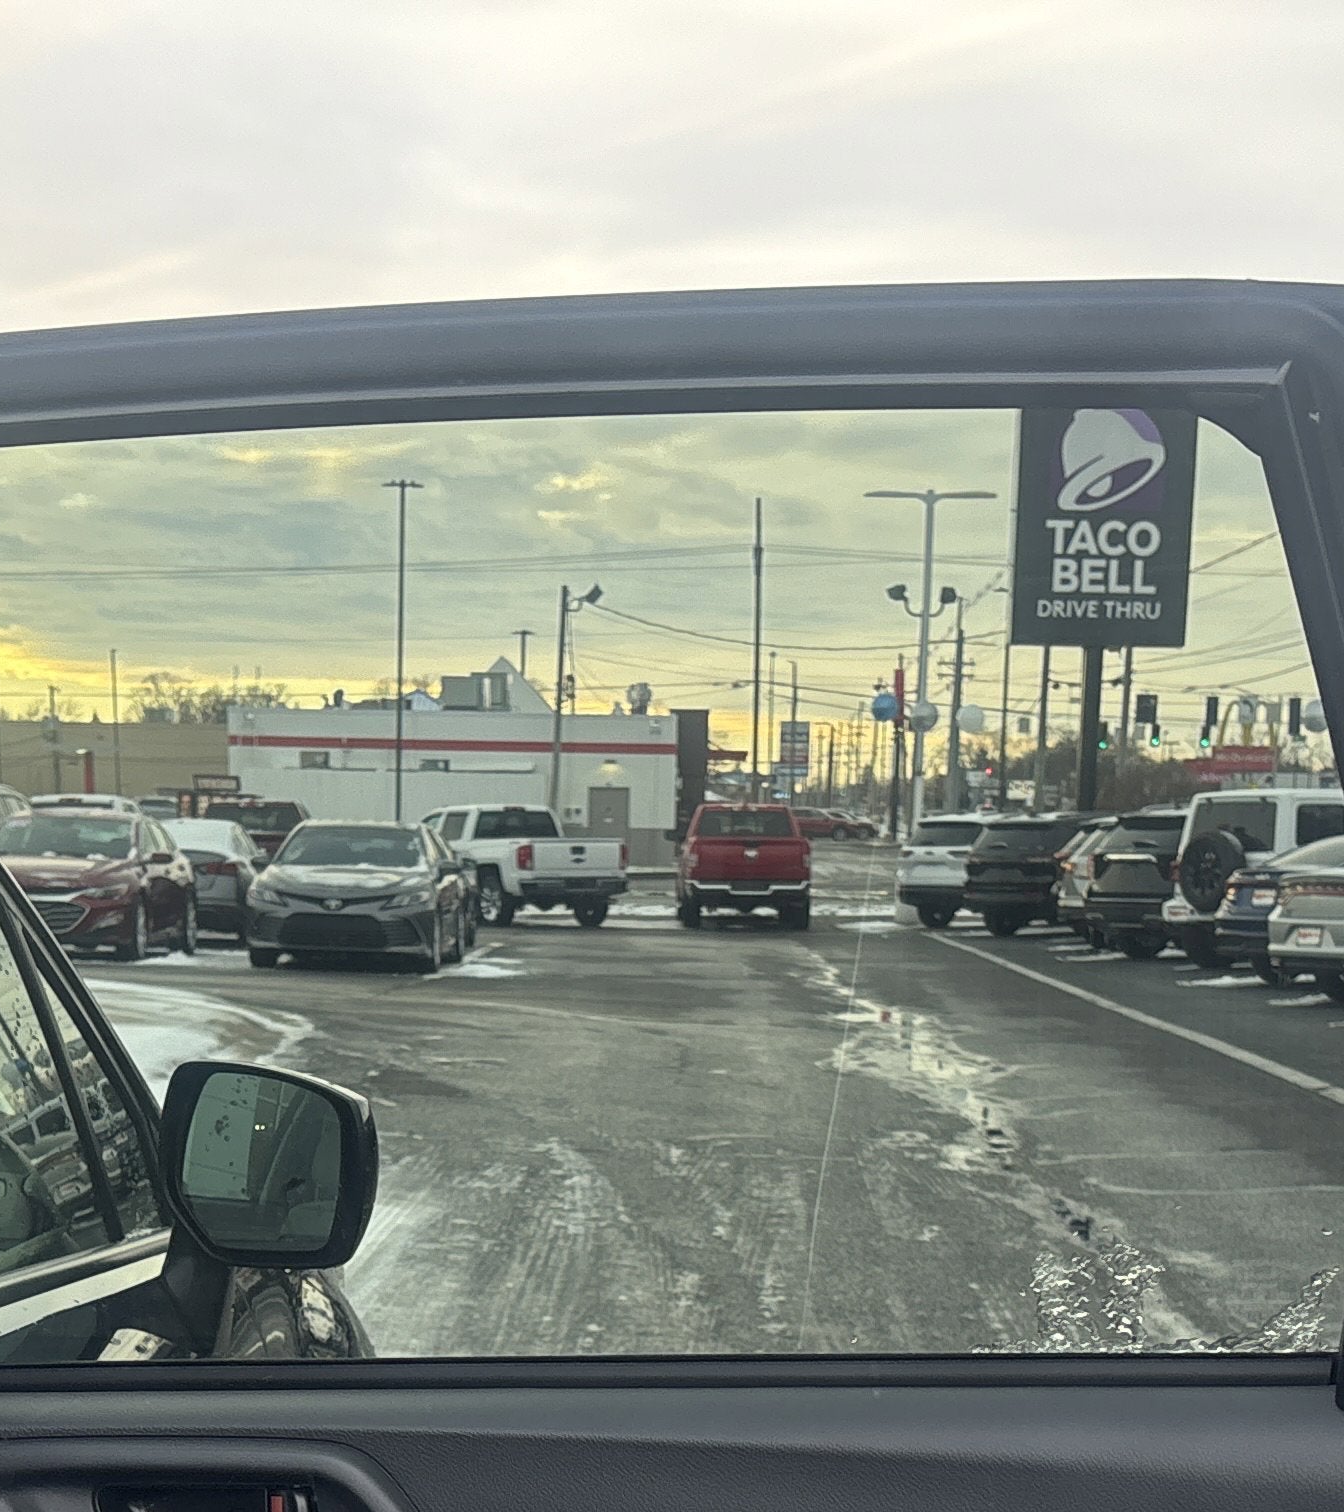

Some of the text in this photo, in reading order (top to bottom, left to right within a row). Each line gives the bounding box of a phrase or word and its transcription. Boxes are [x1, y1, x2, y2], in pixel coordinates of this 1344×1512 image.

[1045, 519, 1161, 557] TACO
[1052, 558, 1157, 595] BELL
[1036, 600, 1162, 620] DRIVE THRU
